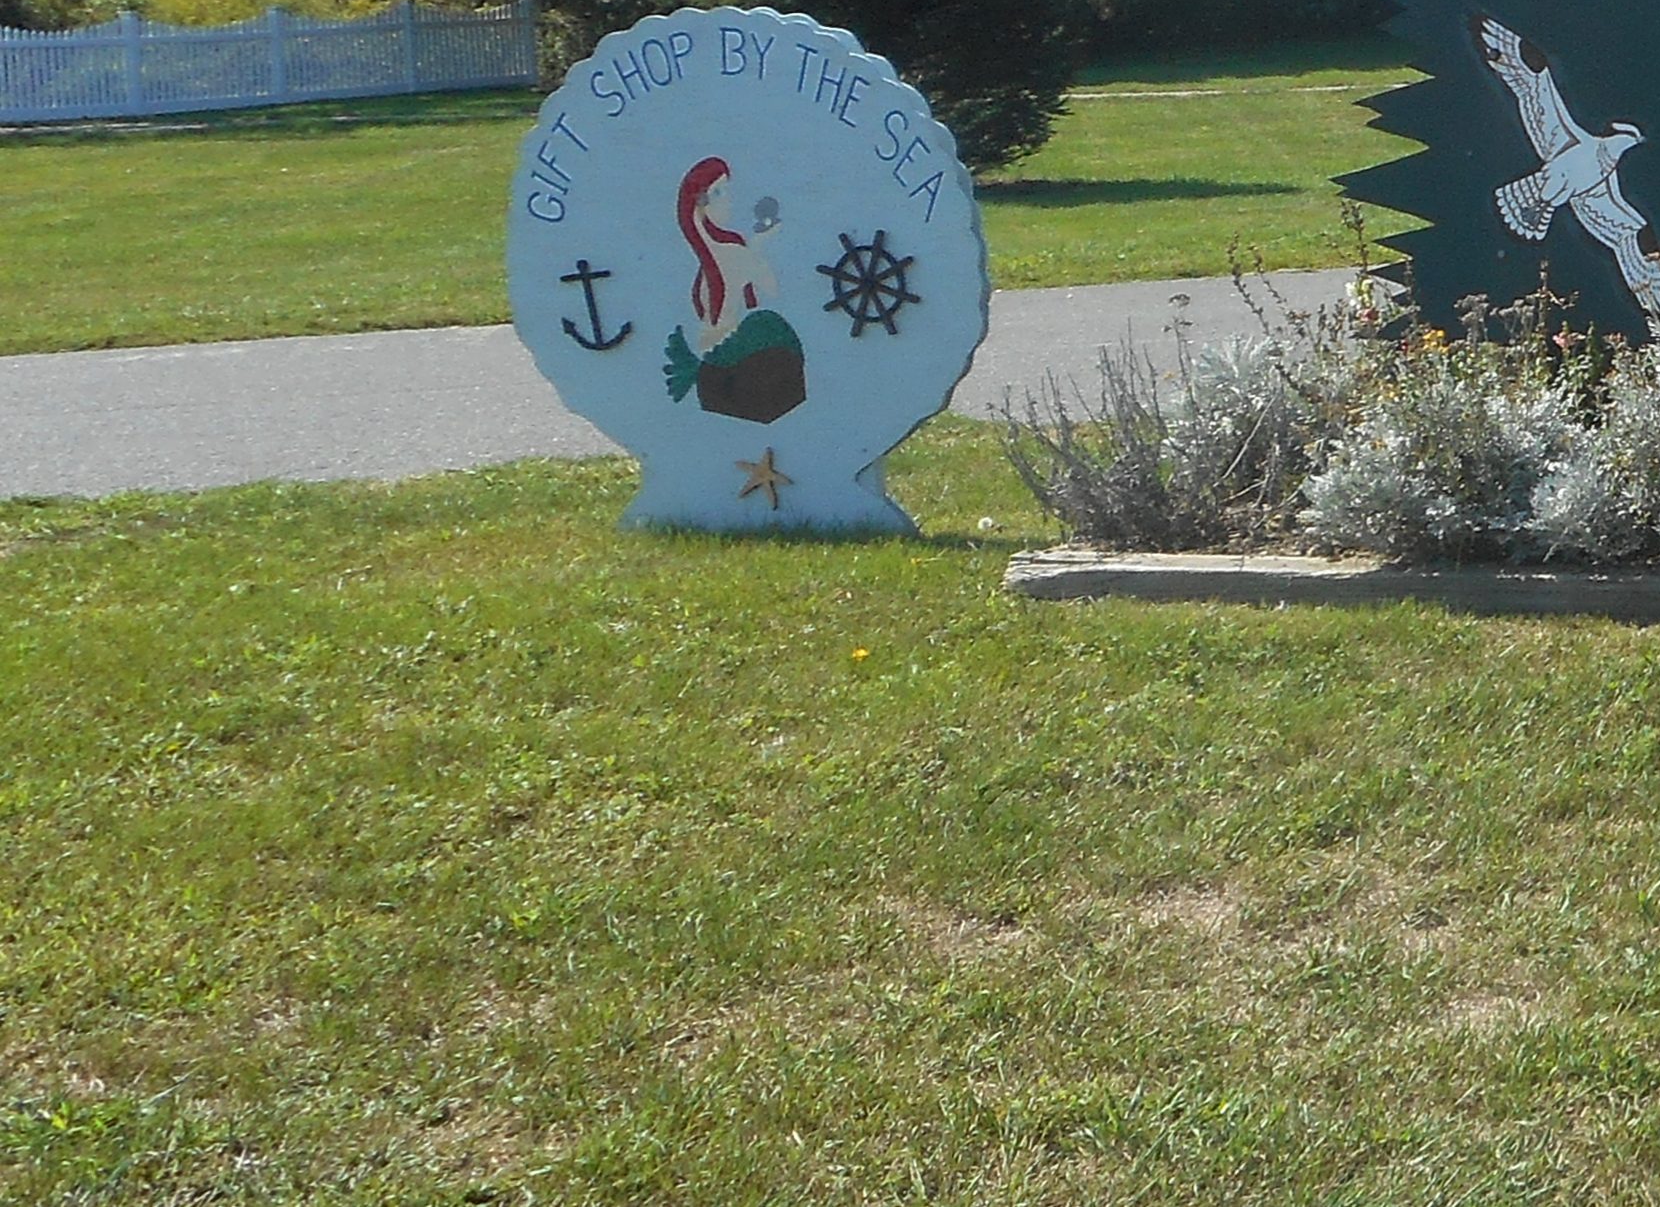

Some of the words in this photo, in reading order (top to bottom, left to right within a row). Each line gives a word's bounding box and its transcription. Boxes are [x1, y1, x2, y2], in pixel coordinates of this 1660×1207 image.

[527, 112, 590, 223] GIFT
[590, 31, 693, 117] SHOP
[720, 27, 775, 80] BY
[796, 43, 870, 128] THE
[875, 109, 946, 223] SEA
